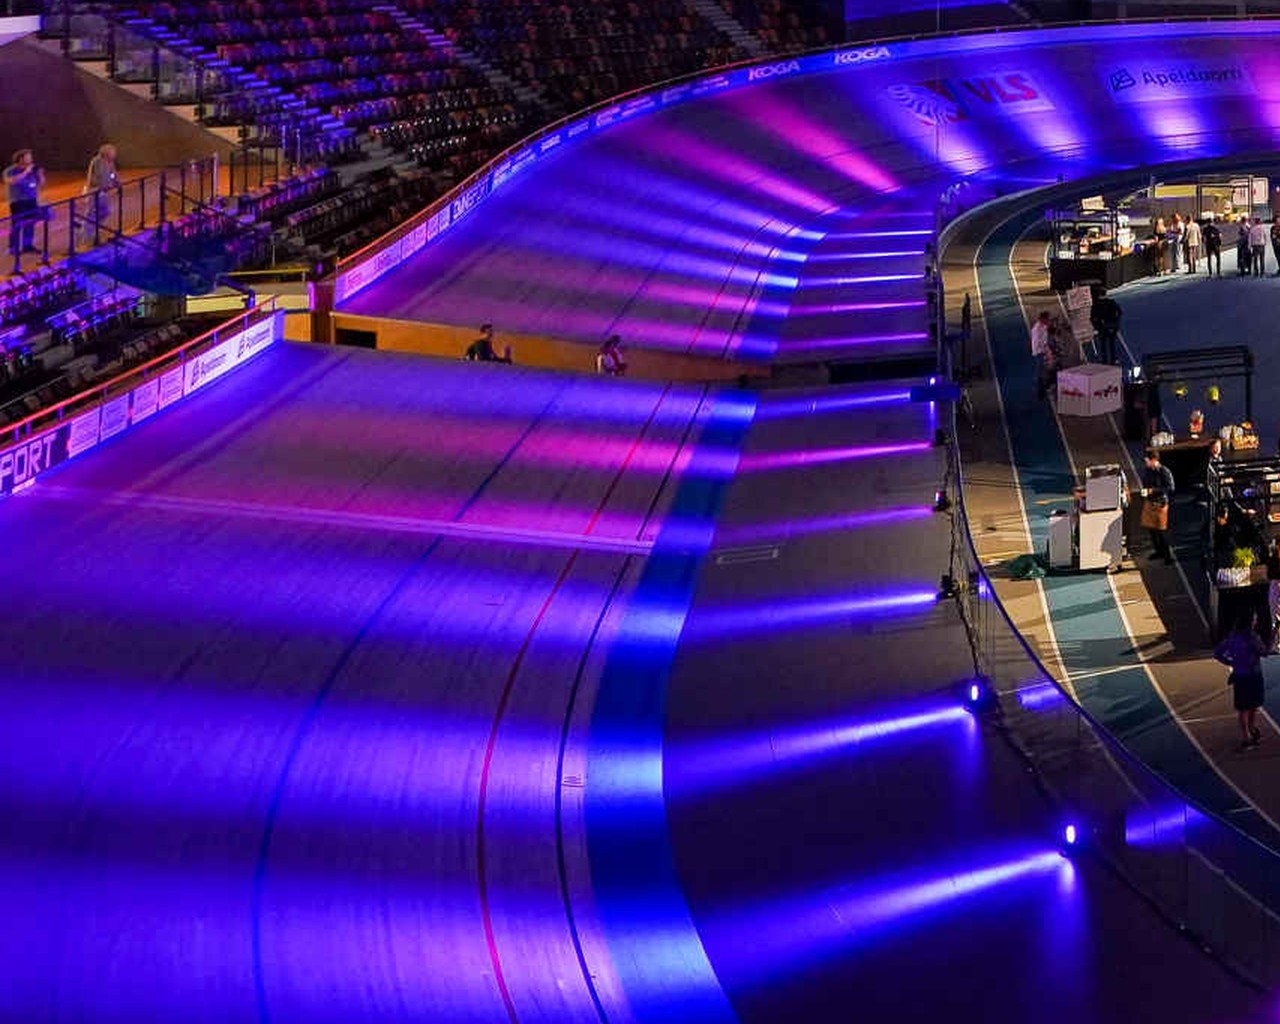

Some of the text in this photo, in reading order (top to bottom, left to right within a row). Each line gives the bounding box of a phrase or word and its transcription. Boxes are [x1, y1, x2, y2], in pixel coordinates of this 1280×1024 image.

[834, 46, 891, 65] KOGA
[748, 61, 801, 82] KOGA
[1142, 64, 1243, 87] Apeldoorn
[0, 432, 58, 492] PORT
